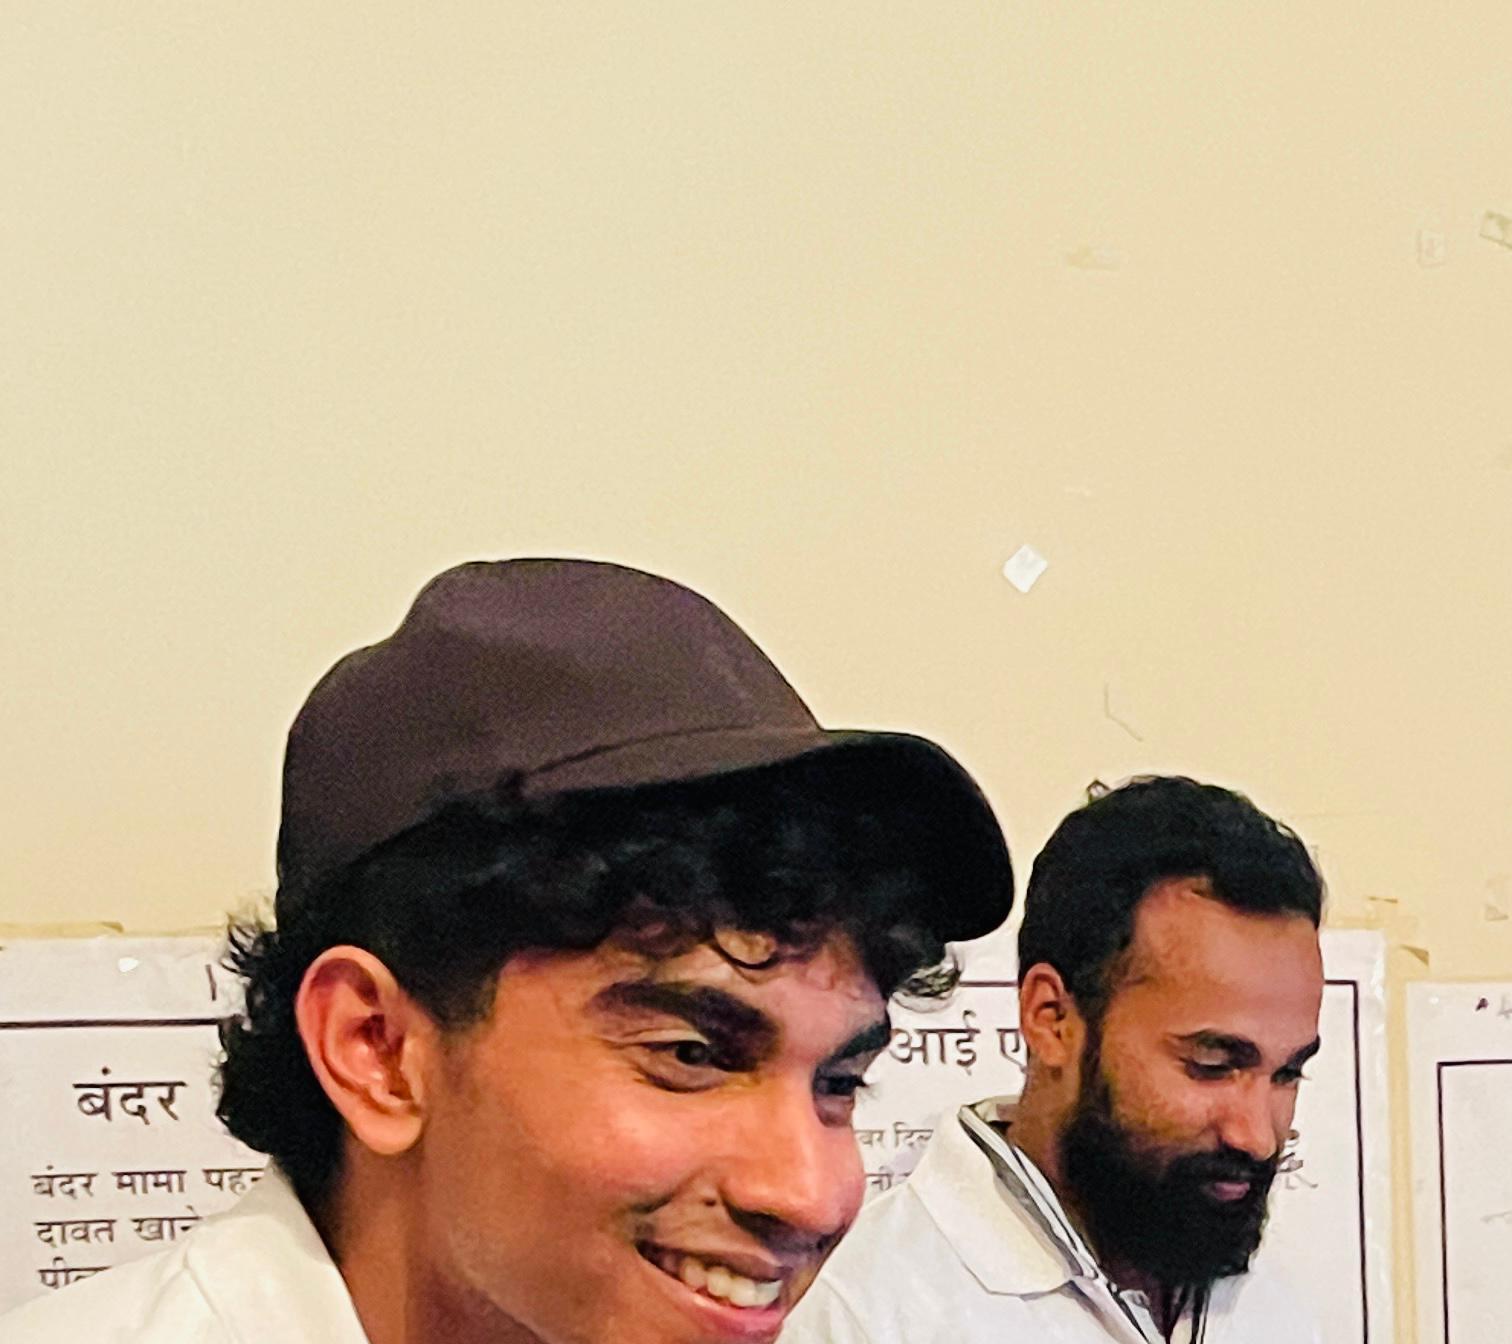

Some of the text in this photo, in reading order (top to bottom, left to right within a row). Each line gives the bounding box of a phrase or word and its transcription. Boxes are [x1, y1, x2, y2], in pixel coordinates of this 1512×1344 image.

[72, 1065, 188, 1126] बंदर
[30, 1164, 98, 1200] बंदर
[111, 1169, 188, 1195] मामा
[34, 1218, 117, 1249] दावत
